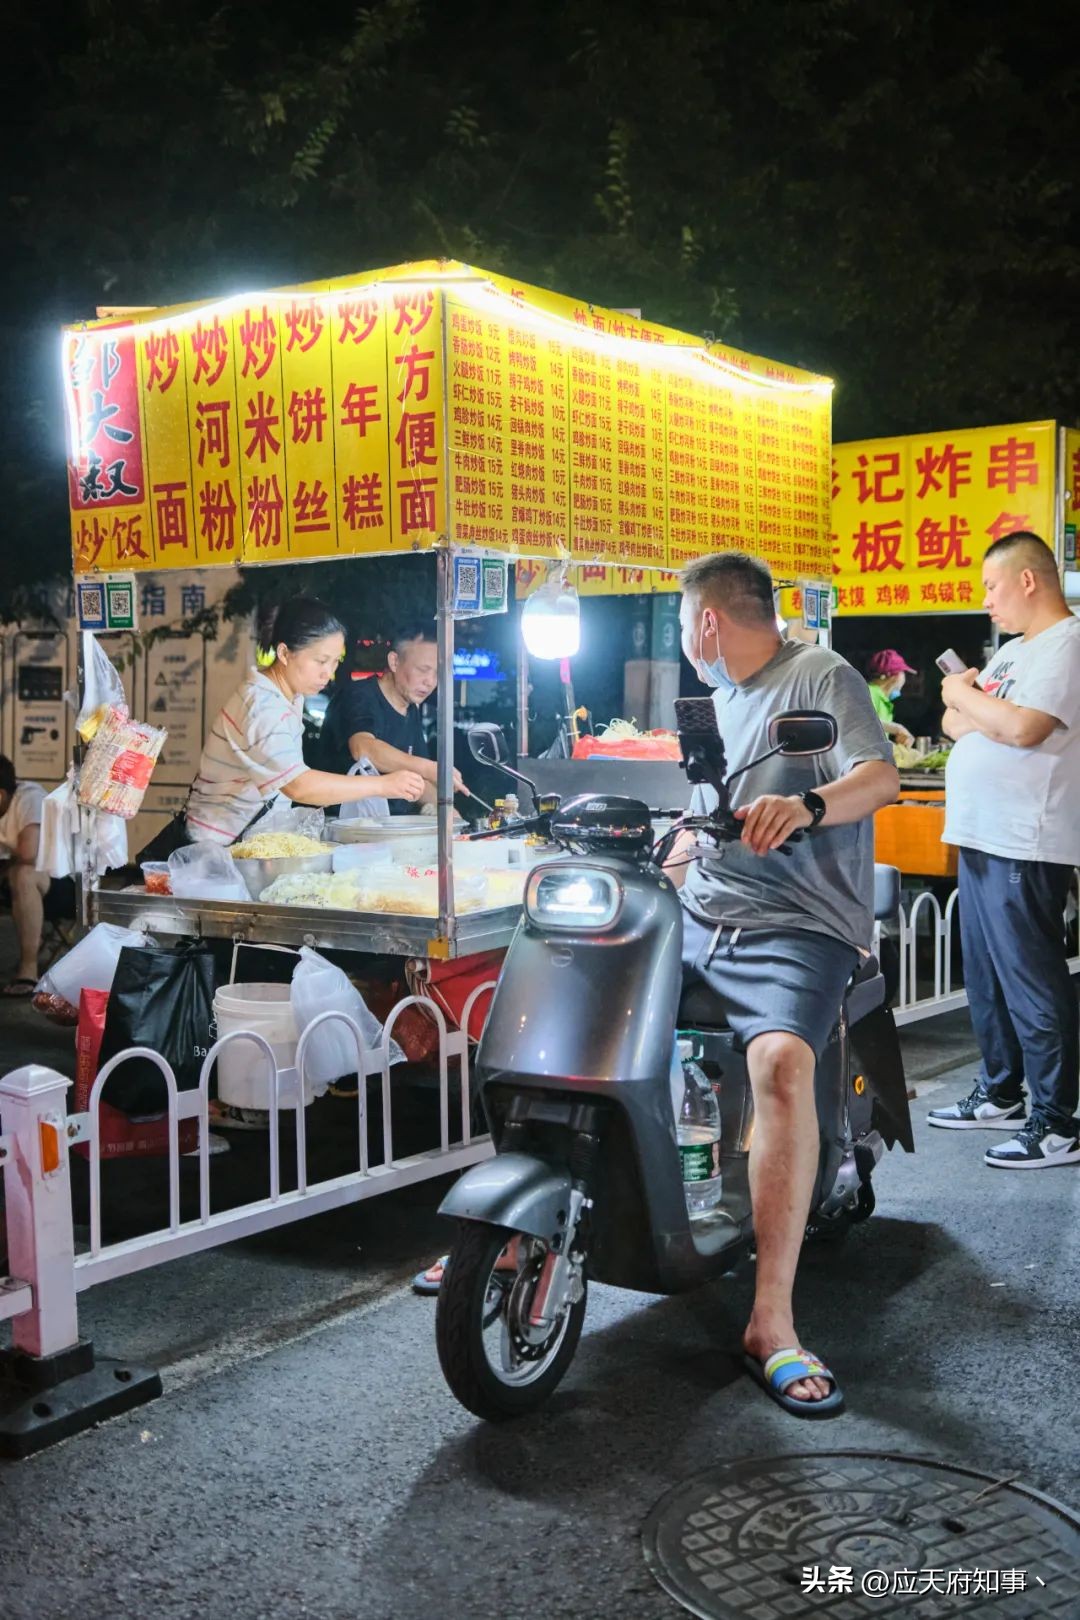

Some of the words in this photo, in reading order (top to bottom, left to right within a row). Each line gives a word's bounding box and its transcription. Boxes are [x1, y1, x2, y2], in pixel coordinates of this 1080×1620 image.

[452, 335, 483, 359] 香肠炒饭
[485, 343, 500, 363] 12元
[452, 359, 483, 382] 火腿炒饭
[486, 367, 501, 386] 11元
[508, 349, 536, 372] 烤鸭炒饭
[550, 359, 563, 378] 14元
[453, 382, 484, 405] 虾仁炒饭
[487, 389, 502, 408] 15元
[509, 372, 543, 395] 辣子鸡炒饭
[550, 381, 564, 400] 14元
[283, 297, 331, 534] 炒饼丝
[336, 292, 384, 530] 炒年糕
[391, 288, 439, 535] 炒方便面
[509, 394, 544, 417] 老干妈炒饭
[552, 403, 565, 421] 10元
[191, 315, 238, 552] 炒河粉
[240, 305, 283, 548] 炒米粉
[487, 412, 502, 431] 14元
[510, 416, 544, 439] 回锅肉炒饭
[552, 425, 565, 443] 14元
[145, 328, 189, 550] 炒面
[454, 428, 484, 450] 三鲜炒饭
[487, 434, 502, 453] 14元
[510, 438, 544, 461] 里脊肉炒饭
[552, 446, 565, 465] 14元
[454, 451, 485, 473] 牛肉炒饭
[488, 457, 503, 476] 15元
[511, 461, 544, 482] 红烧肉炒饭
[552, 468, 565, 486] 15元
[832, 437, 1038, 505] 记炸串
[454, 474, 485, 495] 肥肠炒饭
[488, 479, 503, 498] 15元
[511, 483, 545, 504] 猪头肉炒饭
[552, 490, 566, 507] 14元
[455, 497, 485, 518] 牛肚炒饭
[488, 502, 503, 520] 15元
[76, 513, 151, 567] 炒饭
[832, 510, 1035, 575] 板鱿
[141, 583, 206, 615] 指南
[876, 583, 910, 607] 鸡柳
[921, 580, 974, 604] 鸡锁骨
